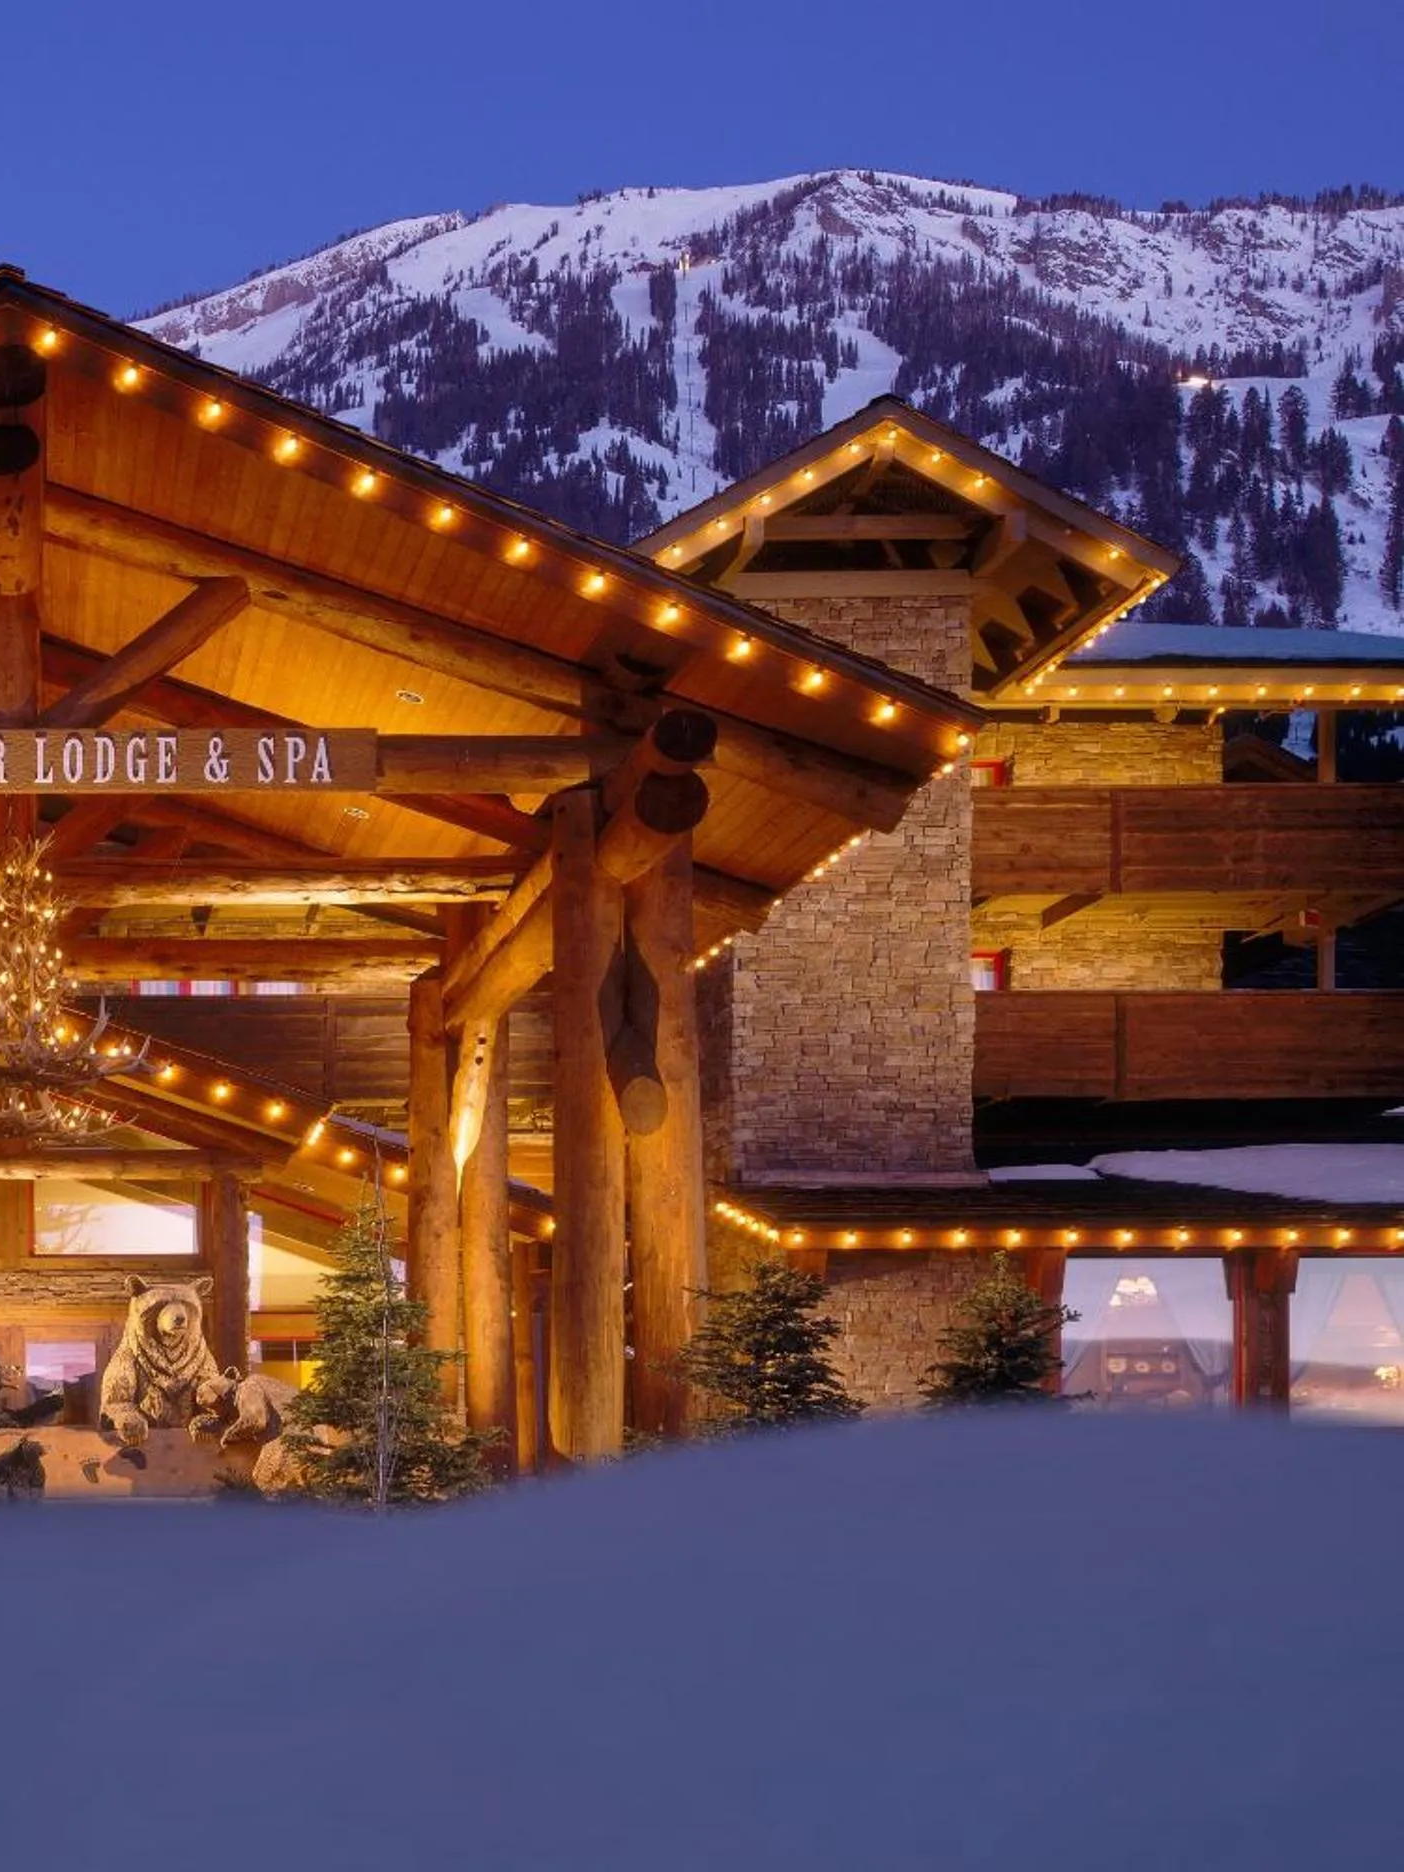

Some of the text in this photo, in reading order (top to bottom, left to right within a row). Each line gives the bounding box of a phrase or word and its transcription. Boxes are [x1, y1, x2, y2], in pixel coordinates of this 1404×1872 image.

[33, 736, 178, 784] LODGE
[203, 736, 230, 784] &
[256, 736, 333, 784] SPA
